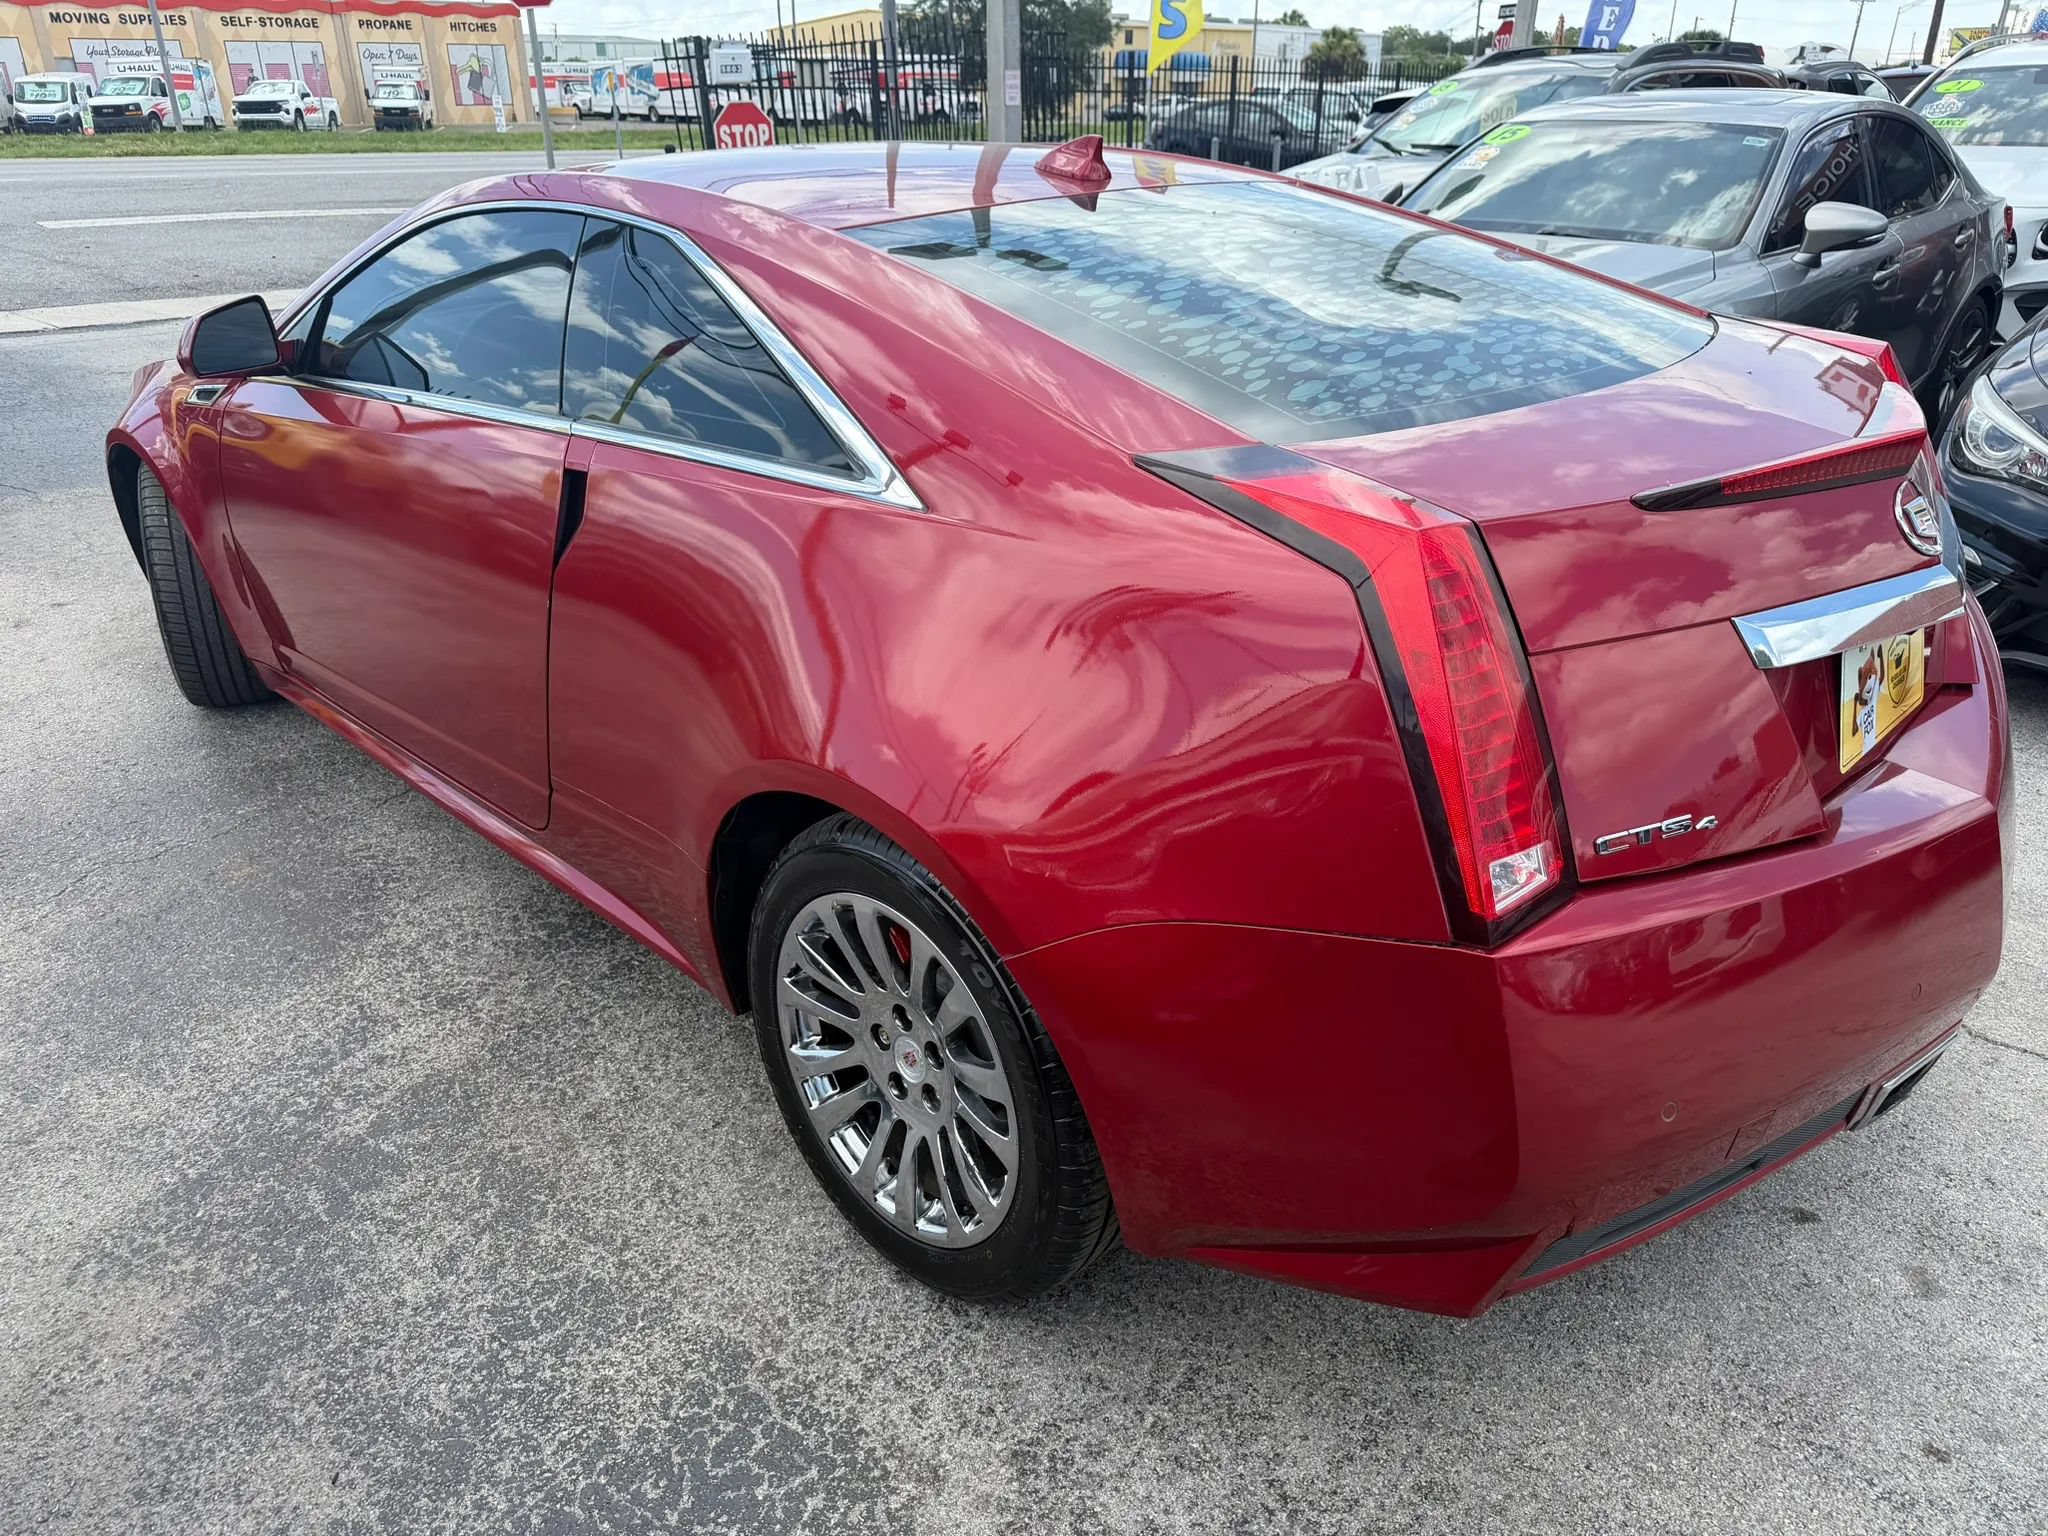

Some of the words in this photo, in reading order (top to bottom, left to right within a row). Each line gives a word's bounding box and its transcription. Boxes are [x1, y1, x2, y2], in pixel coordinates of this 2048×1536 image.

[49, 12, 110, 24] MOVING
[220, 16, 320, 28] SELF-STORAGE
[358, 19, 412, 30] PROPANE
[450, 22, 497, 32] HITCHES
[1493, 32, 1513, 51] STO
[86, 45, 109, 57] Your
[111, 45, 145, 57] Storage
[145, 46, 172, 57] Plae
[362, 48, 387, 62] Open
[395, 49, 419, 62] Days
[117, 64, 158, 72] U-HAUL
[720, 123, 769, 149] STOP
